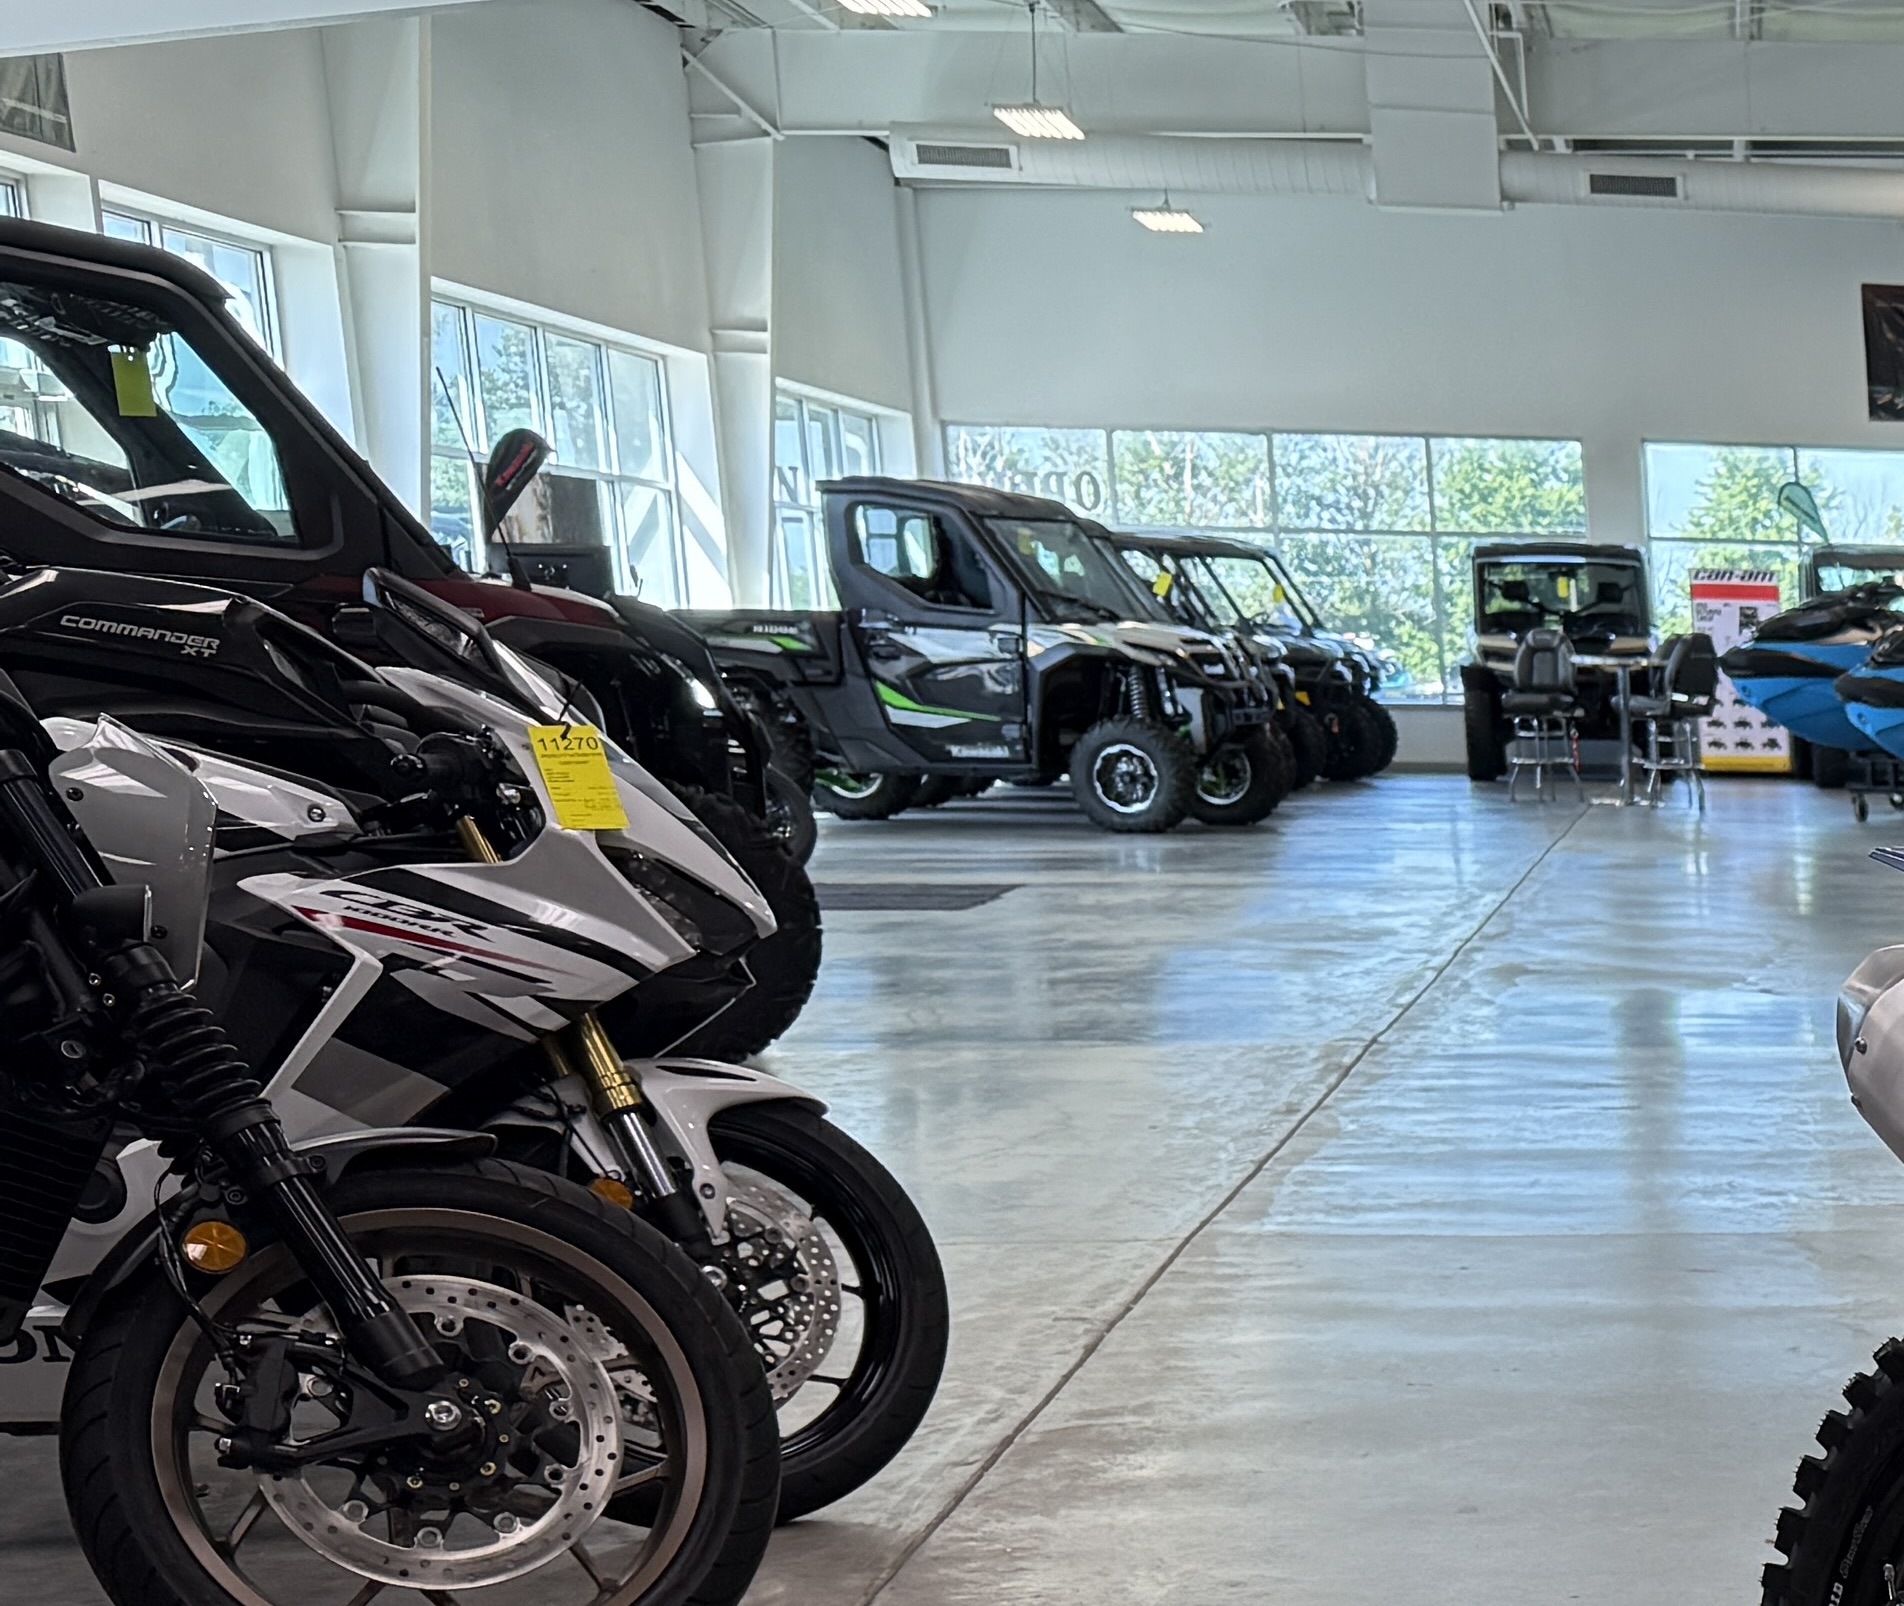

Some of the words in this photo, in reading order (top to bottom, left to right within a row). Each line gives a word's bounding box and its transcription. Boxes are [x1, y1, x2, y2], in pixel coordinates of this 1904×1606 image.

[60, 614, 221, 650] COMMANDER
[180, 644, 217, 657] XT
[536, 735, 599, 752] 11270
[319, 889, 496, 943] CBR
